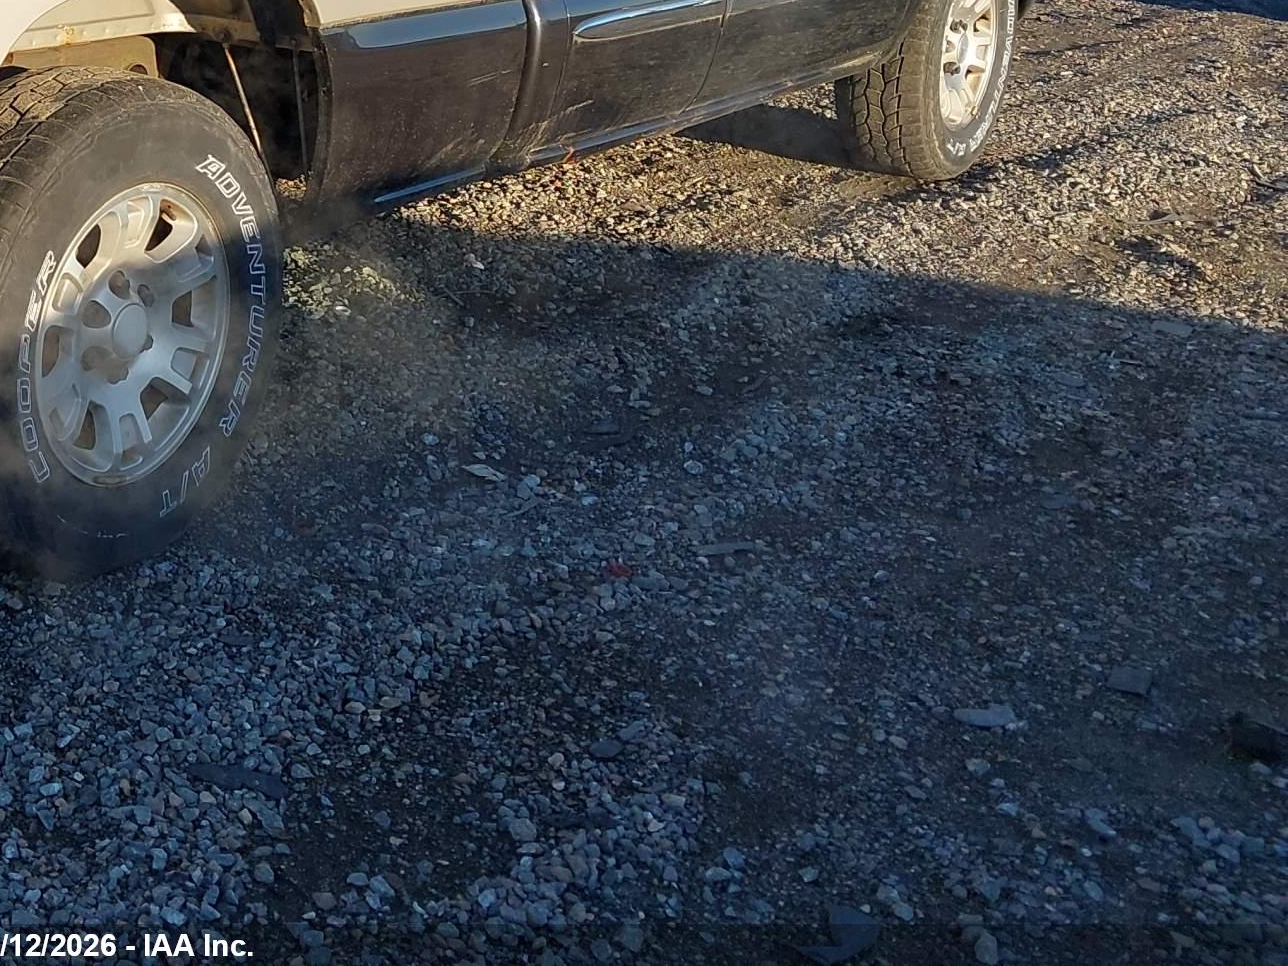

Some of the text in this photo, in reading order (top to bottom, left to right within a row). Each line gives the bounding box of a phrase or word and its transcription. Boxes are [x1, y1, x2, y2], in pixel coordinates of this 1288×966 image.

[16, 249, 58, 484] COOPER
[159, 153, 268, 518] ADVENTURER A/T
